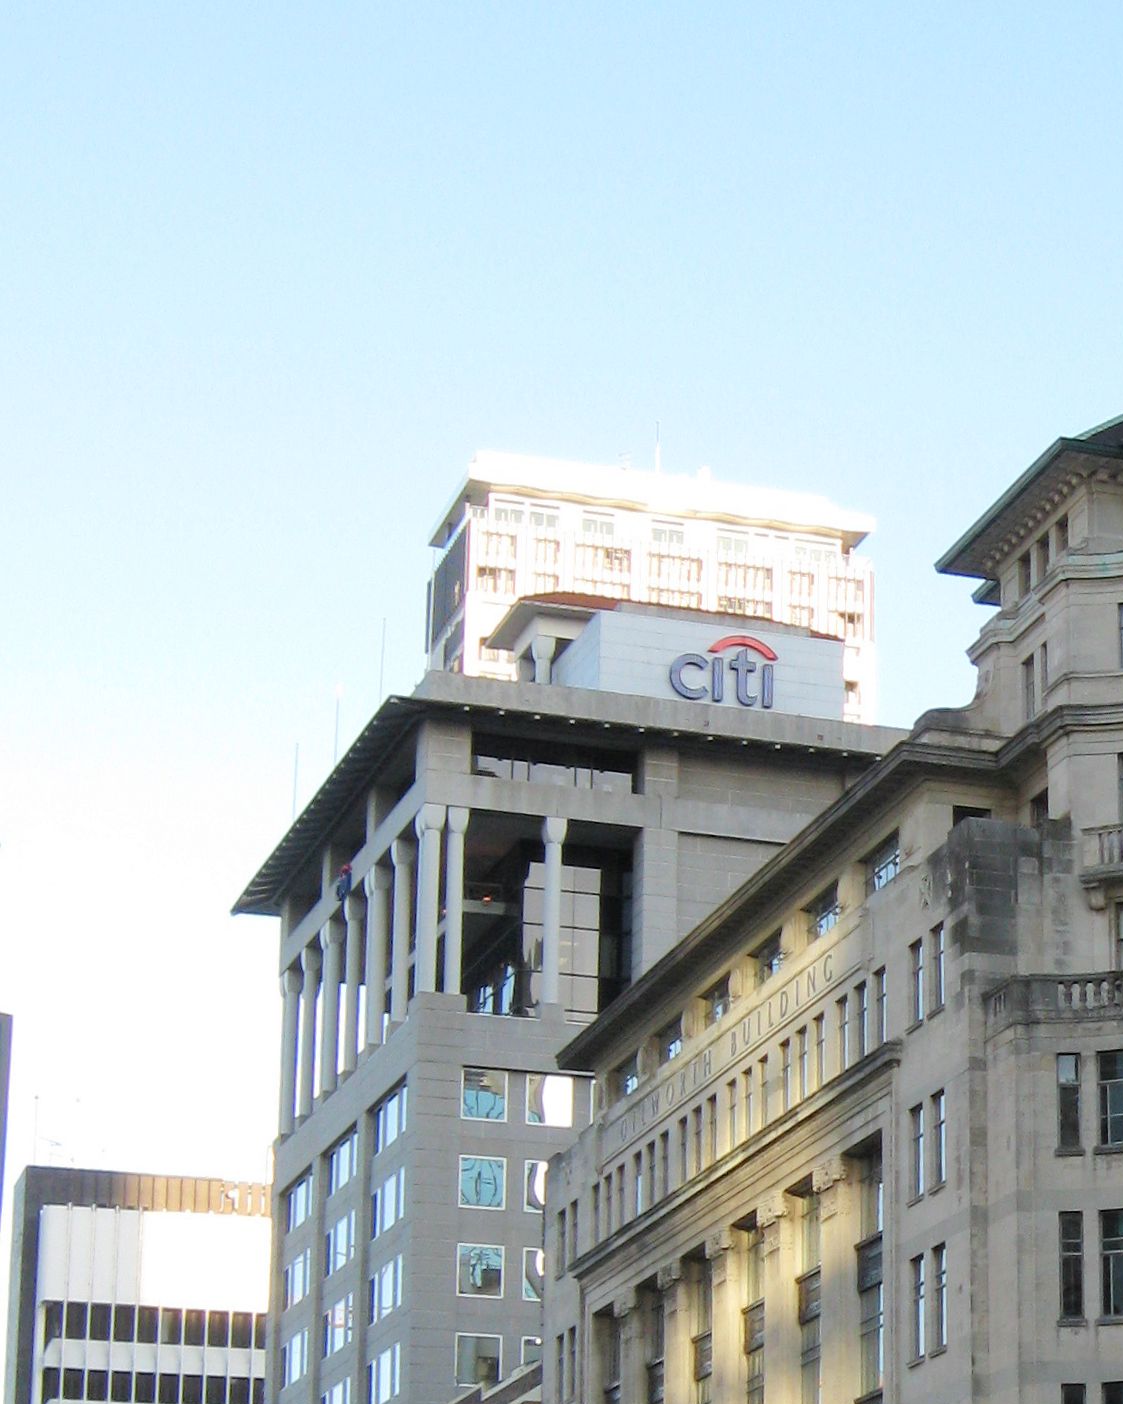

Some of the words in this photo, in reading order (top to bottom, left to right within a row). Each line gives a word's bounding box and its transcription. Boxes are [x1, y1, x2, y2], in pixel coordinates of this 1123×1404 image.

[670, 648, 774, 708] citi
[619, 1048, 713, 1142] DILWORTH
[730, 953, 836, 1058] BUILDING
